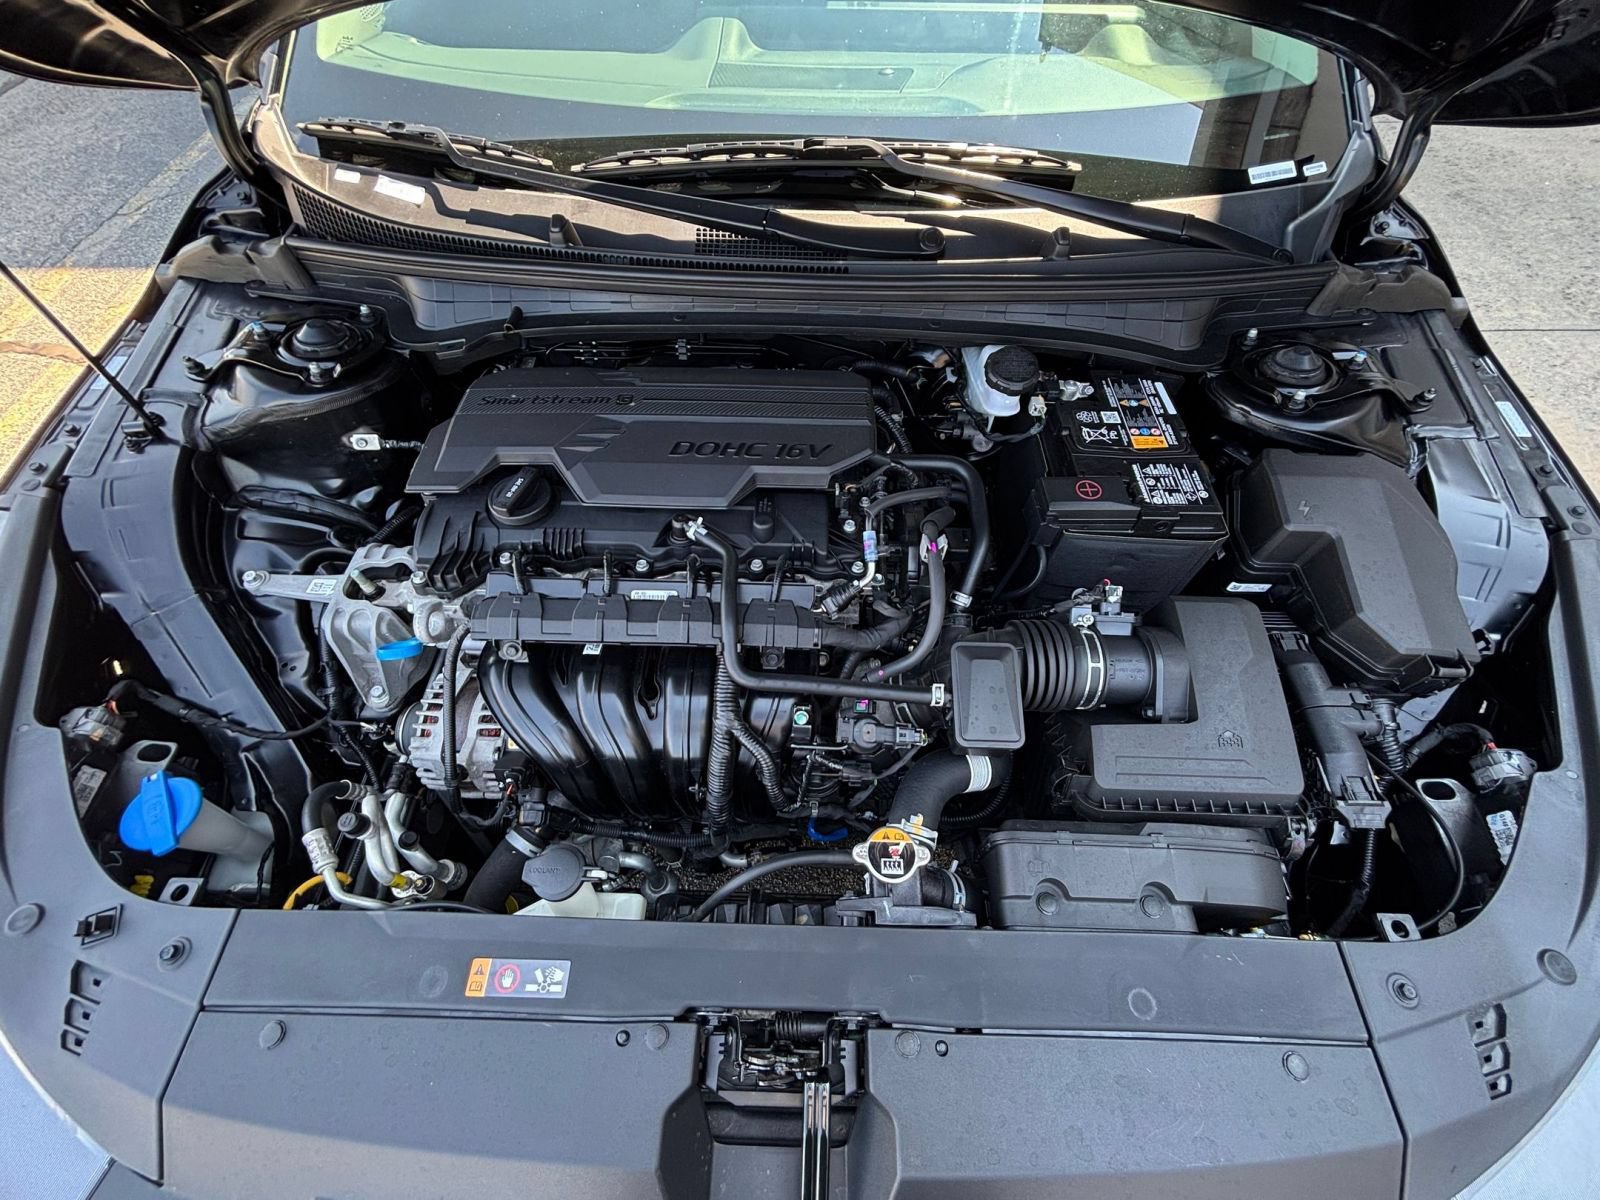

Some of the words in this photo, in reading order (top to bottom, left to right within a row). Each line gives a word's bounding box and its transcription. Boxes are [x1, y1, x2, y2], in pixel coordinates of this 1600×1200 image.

[478, 394, 612, 406] Smartstream
[667, 440, 770, 459] DOHC
[774, 442, 833, 460] 16V
